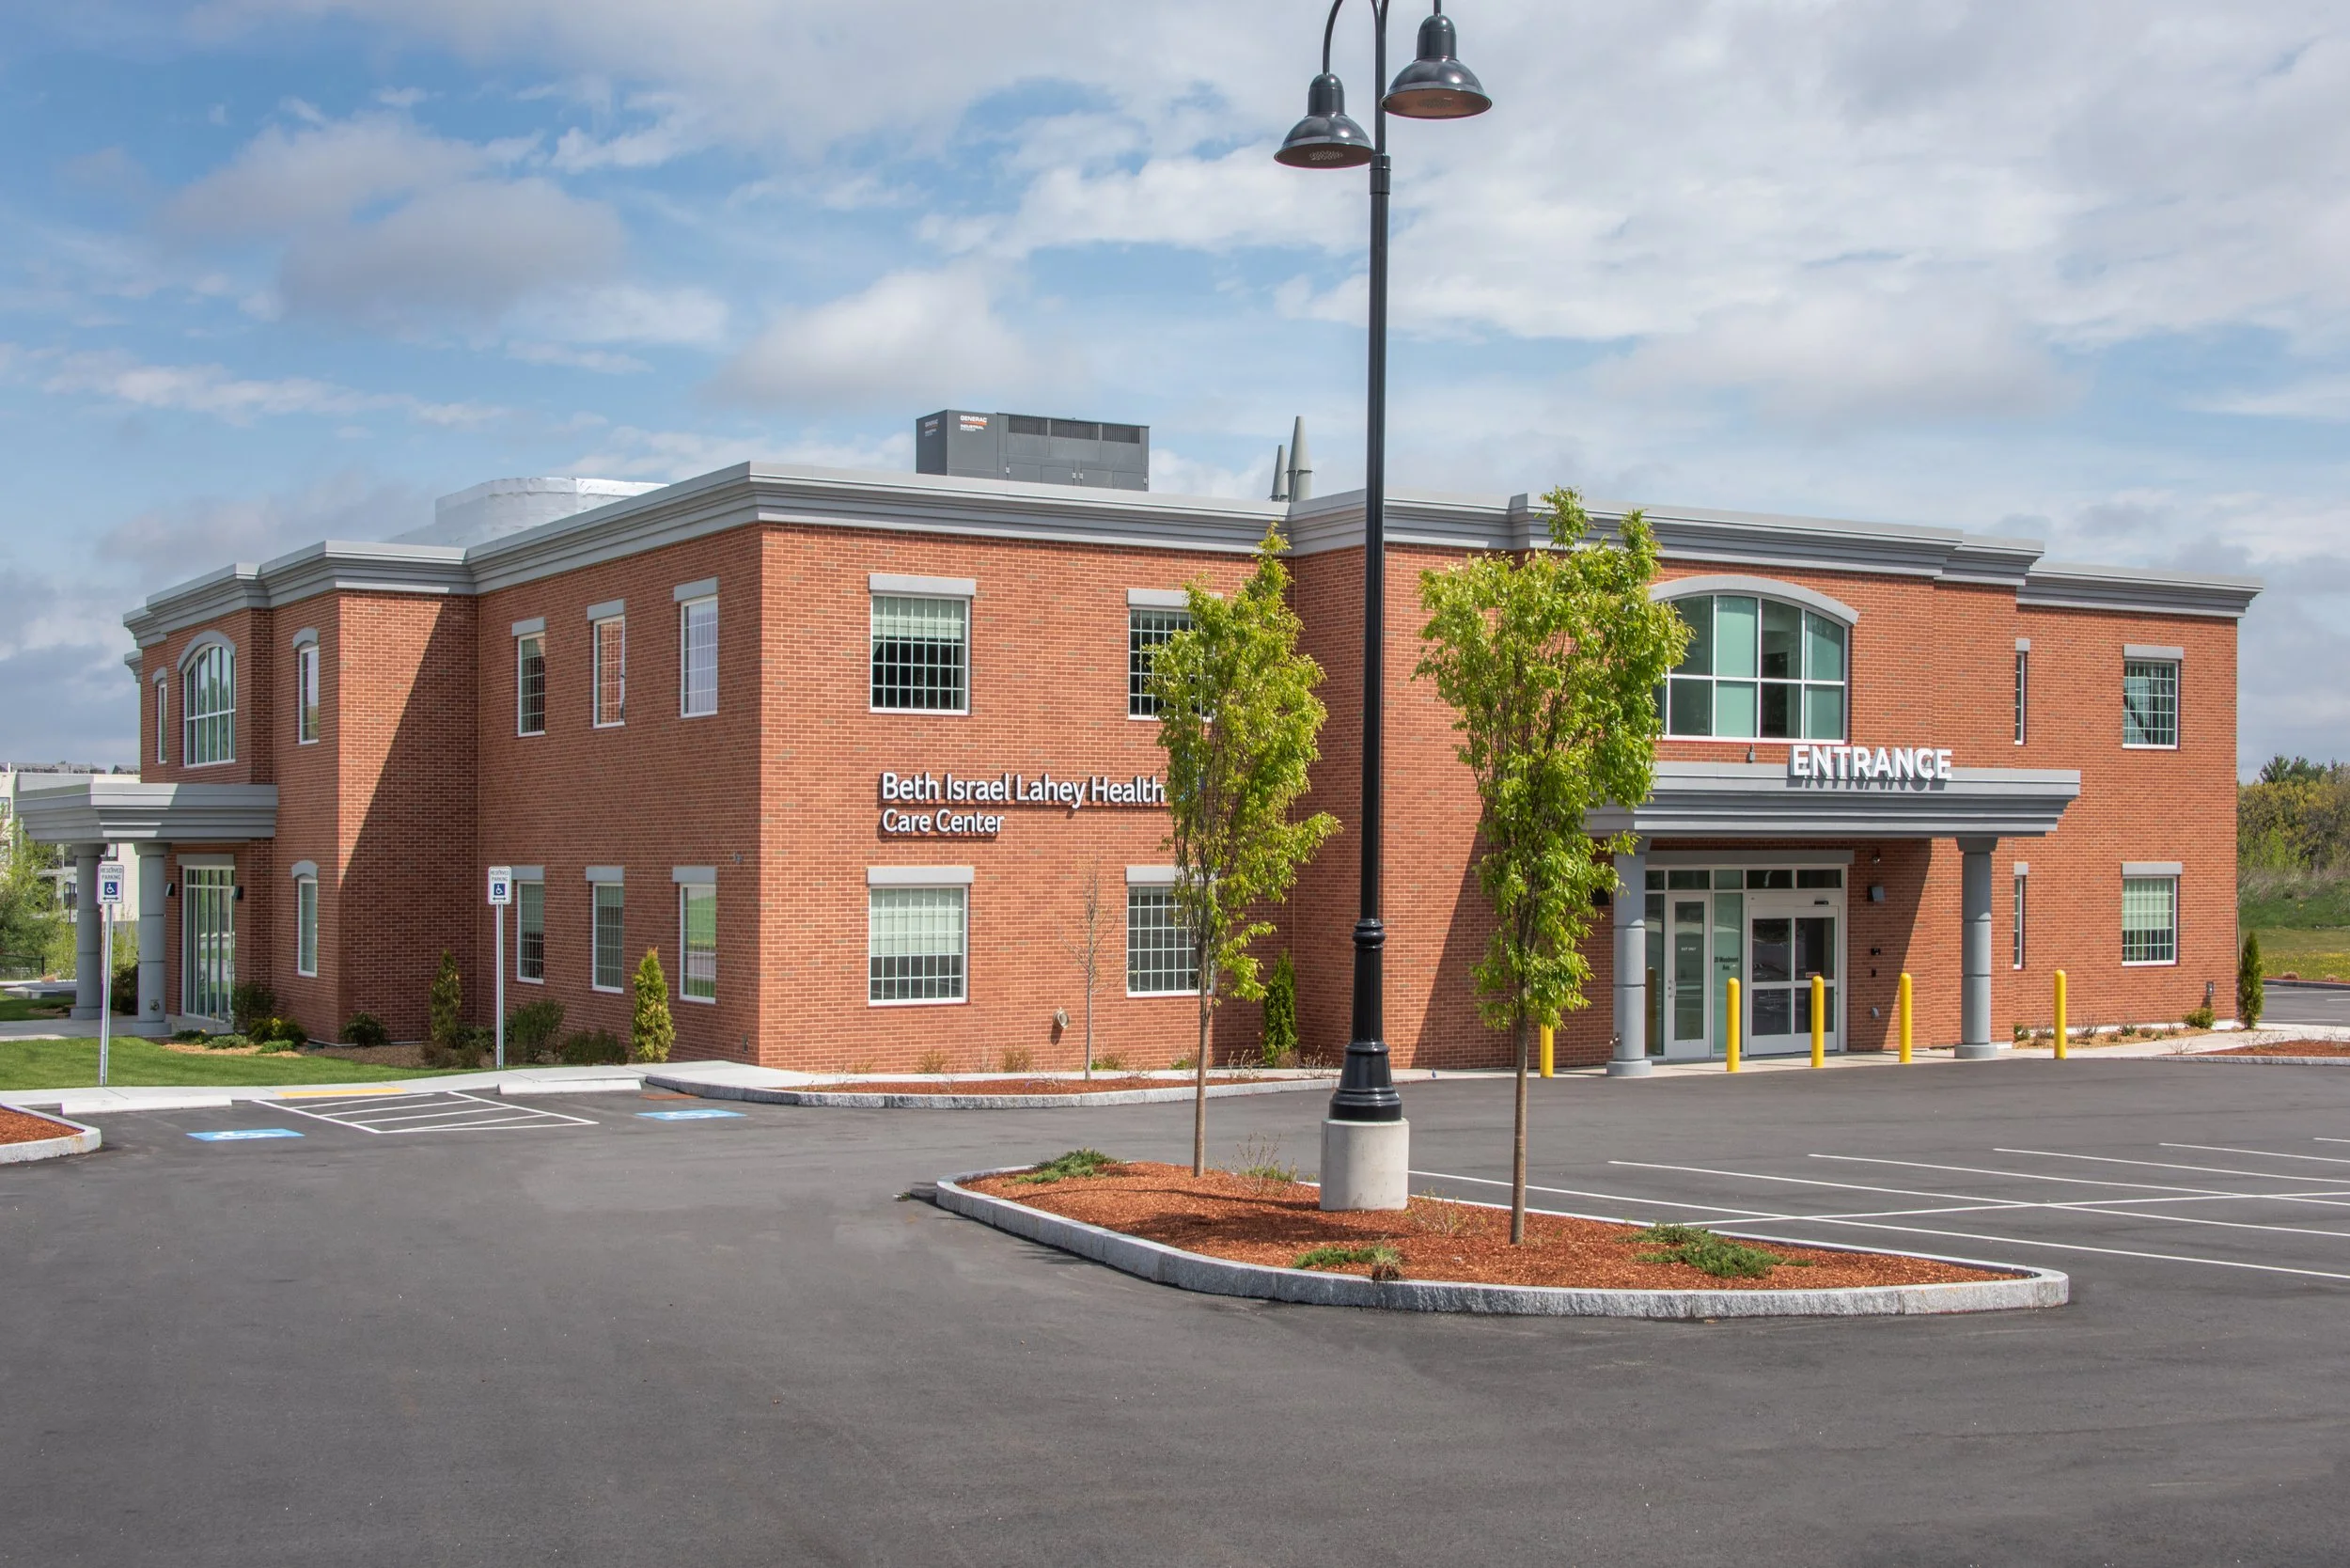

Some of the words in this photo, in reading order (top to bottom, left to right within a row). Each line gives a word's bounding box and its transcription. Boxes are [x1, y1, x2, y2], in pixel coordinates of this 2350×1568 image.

[1790, 745, 1953, 779] ENTRANCE
[881, 772, 940, 801] Beth
[946, 772, 1011, 801] Israel
[1016, 773, 1088, 809] Lahey
[1091, 775, 1165, 804] Health
[882, 808, 932, 833] Care
[935, 808, 1006, 833] Center
